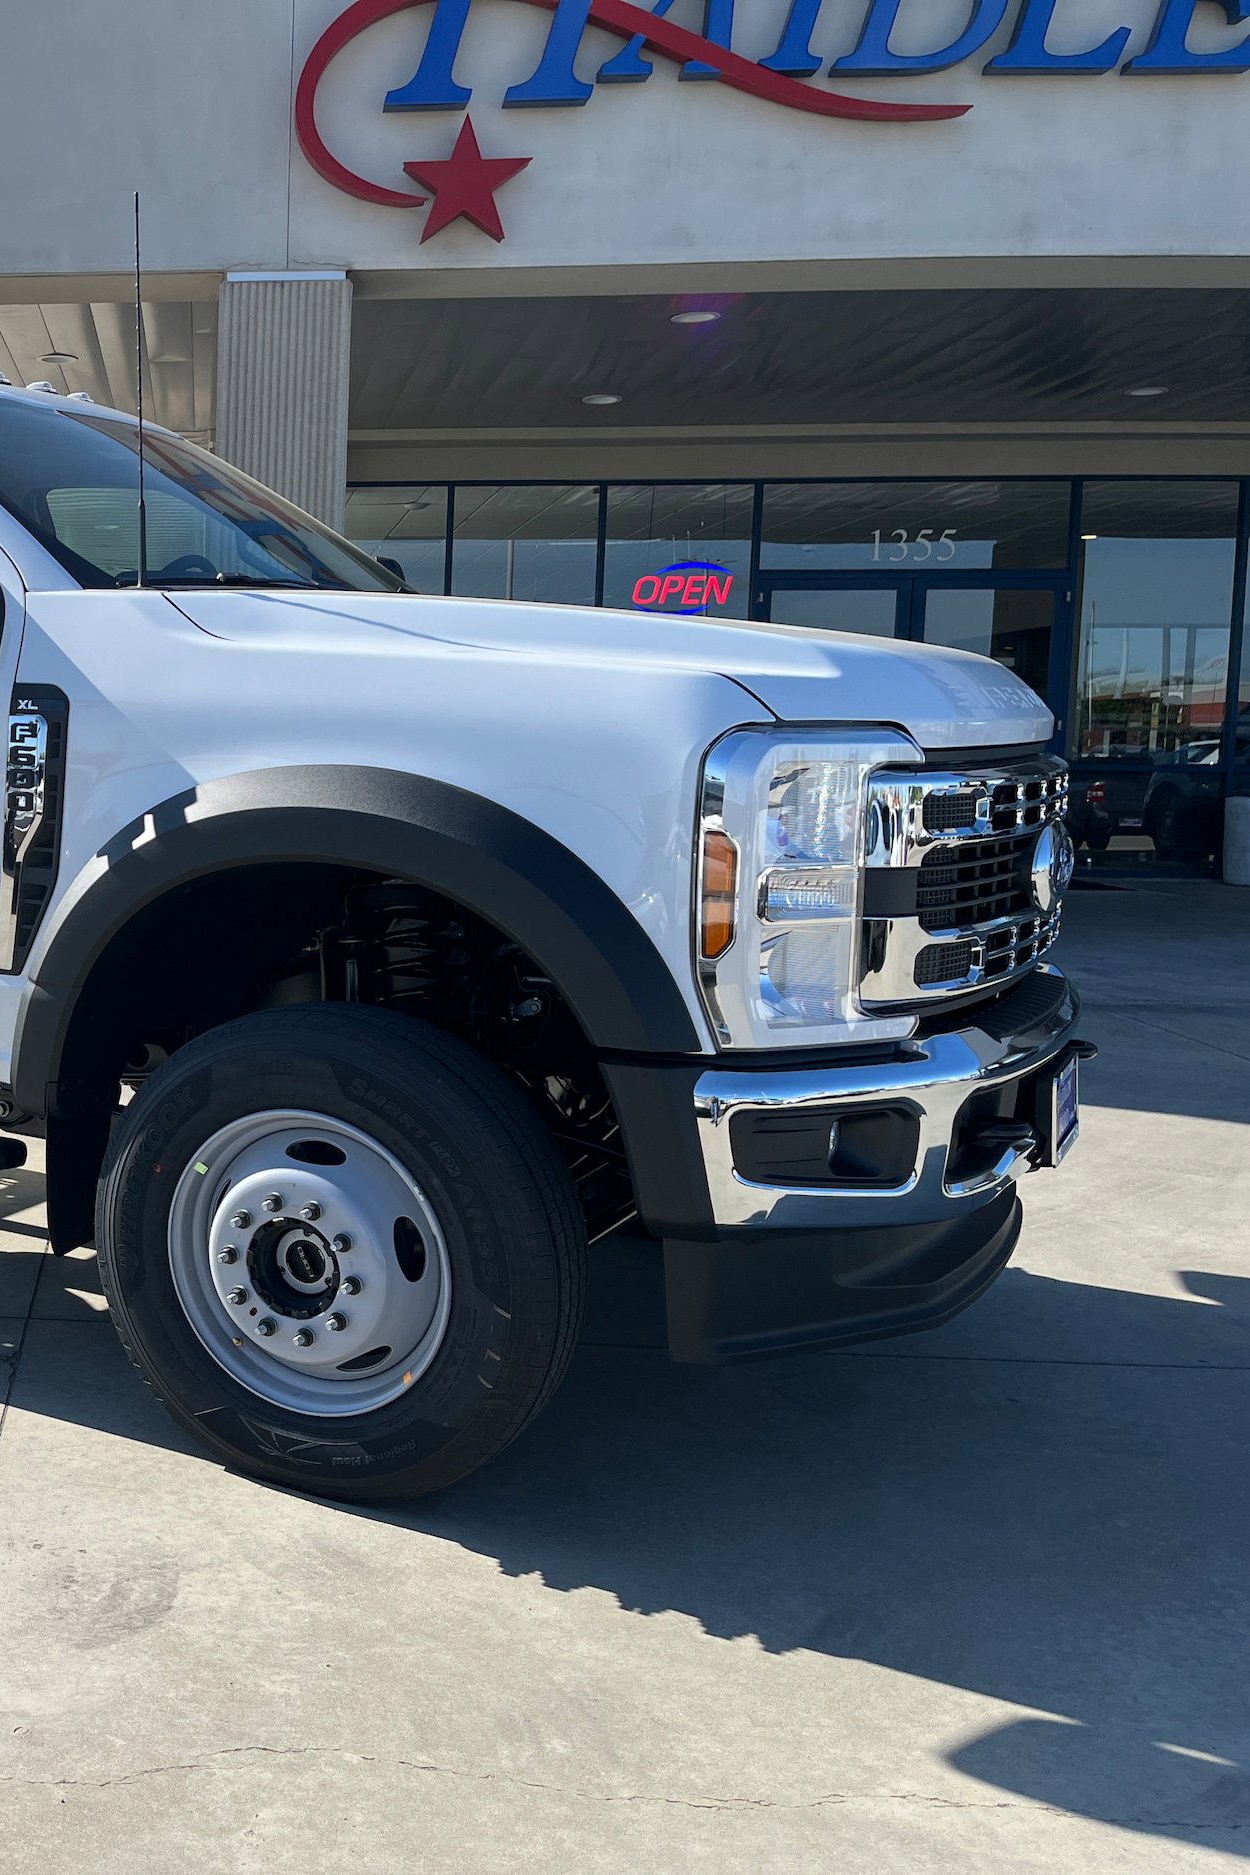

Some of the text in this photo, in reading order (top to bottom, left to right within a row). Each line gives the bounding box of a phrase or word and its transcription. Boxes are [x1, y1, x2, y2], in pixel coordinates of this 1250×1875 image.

[869, 528, 958, 562] 1355
[632, 576, 734, 605] OPEN
[17, 699, 39, 710] XL
[364, 1438, 417, 1466] Regional
